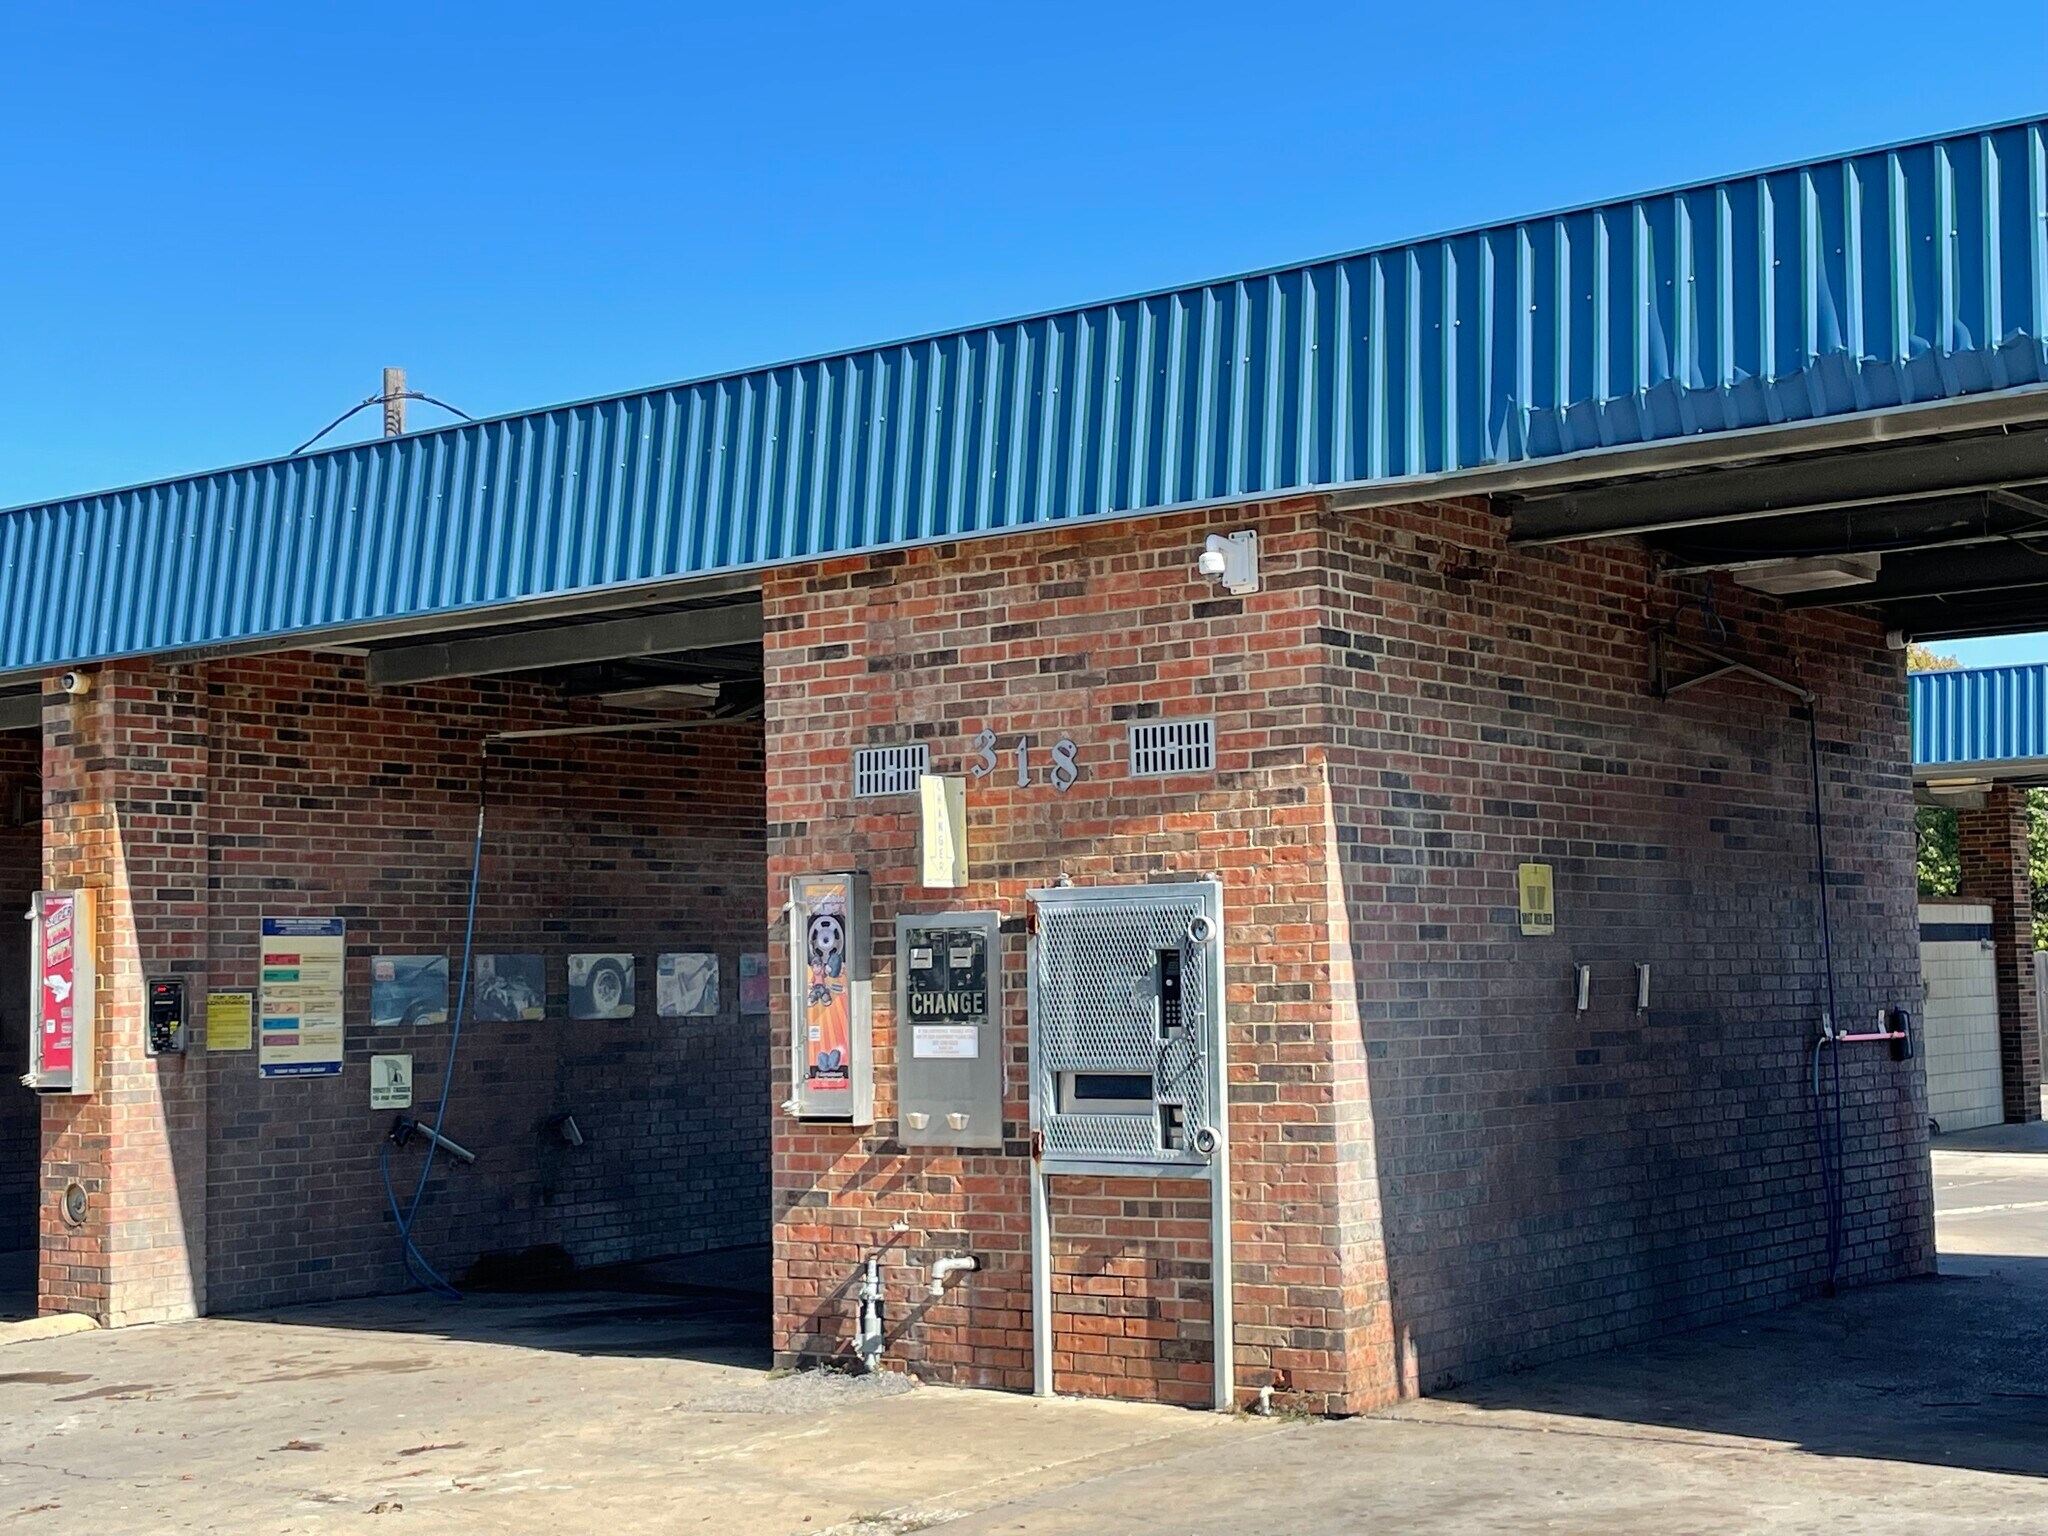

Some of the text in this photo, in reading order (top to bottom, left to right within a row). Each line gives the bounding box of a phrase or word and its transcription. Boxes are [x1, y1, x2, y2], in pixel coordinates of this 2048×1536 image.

[970, 728, 1078, 792] 318
[936, 780, 944, 872] CHANGER
[911, 993, 983, 1015] CHANGE
